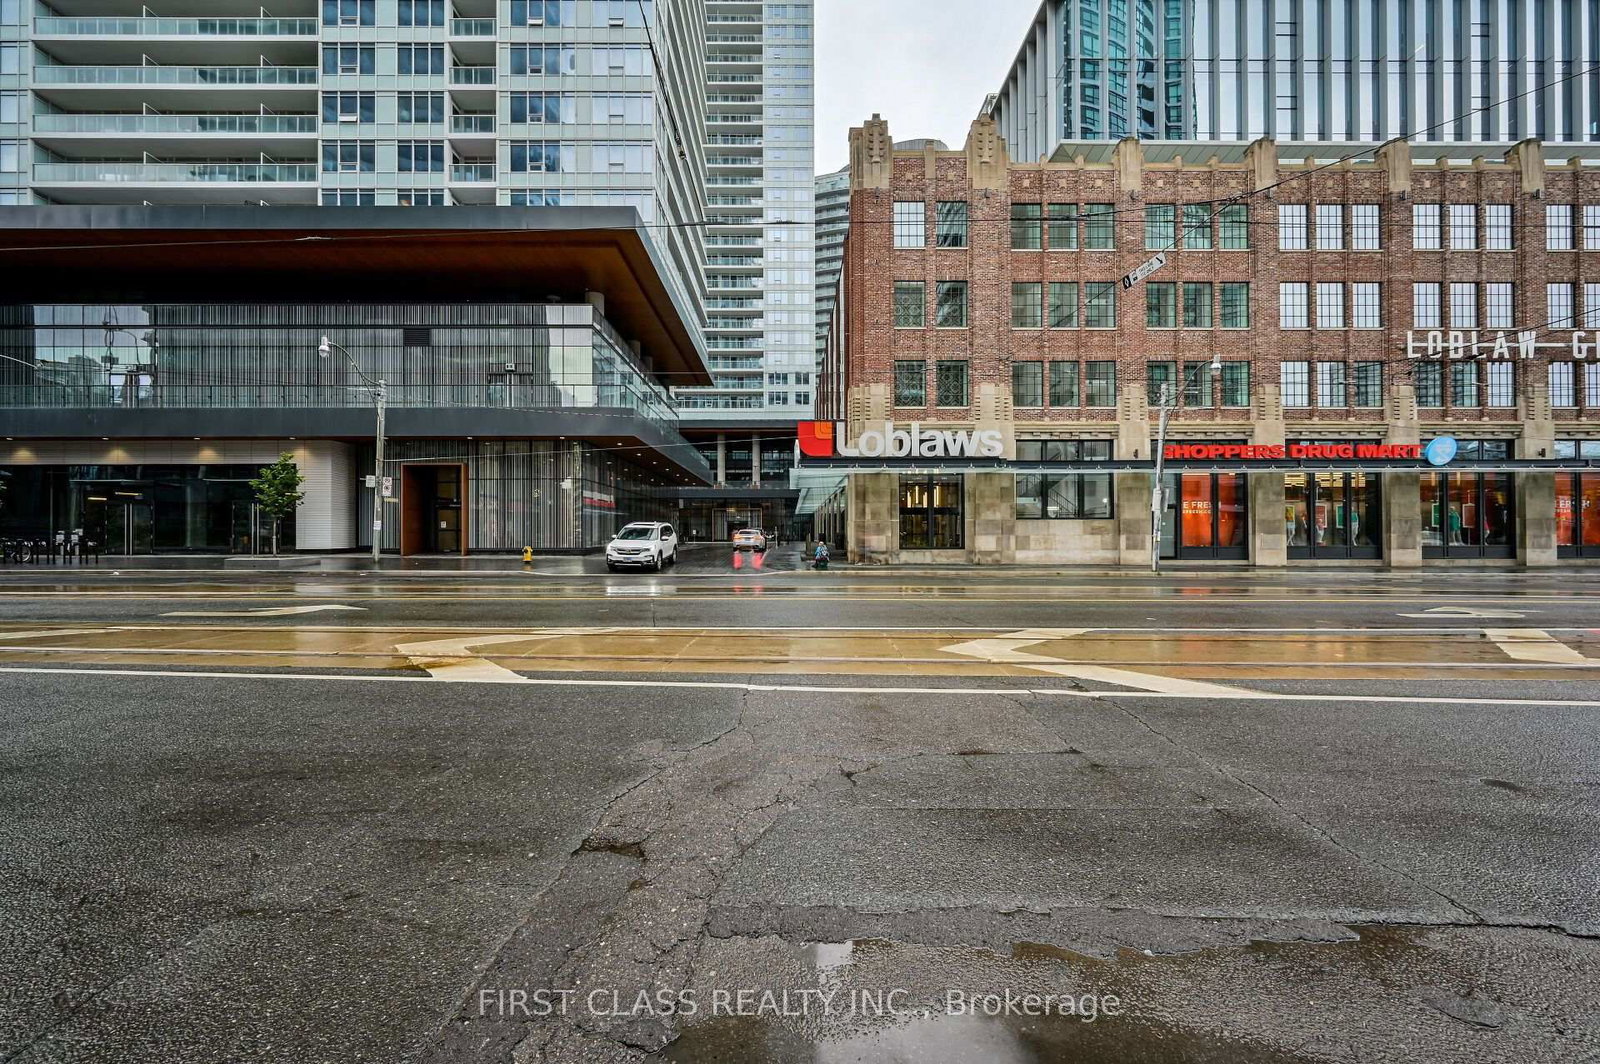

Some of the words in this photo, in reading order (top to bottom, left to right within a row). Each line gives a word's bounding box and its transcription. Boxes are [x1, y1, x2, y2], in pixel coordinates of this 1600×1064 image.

[1407, 331, 1537, 359] LOBLAW
[1572, 331, 1600, 359] G
[836, 422, 1004, 457] Loblaws
[1163, 444, 1286, 459] SHOPPERS
[1290, 444, 1354, 459] DRUG
[1356, 444, 1424, 459] MART
